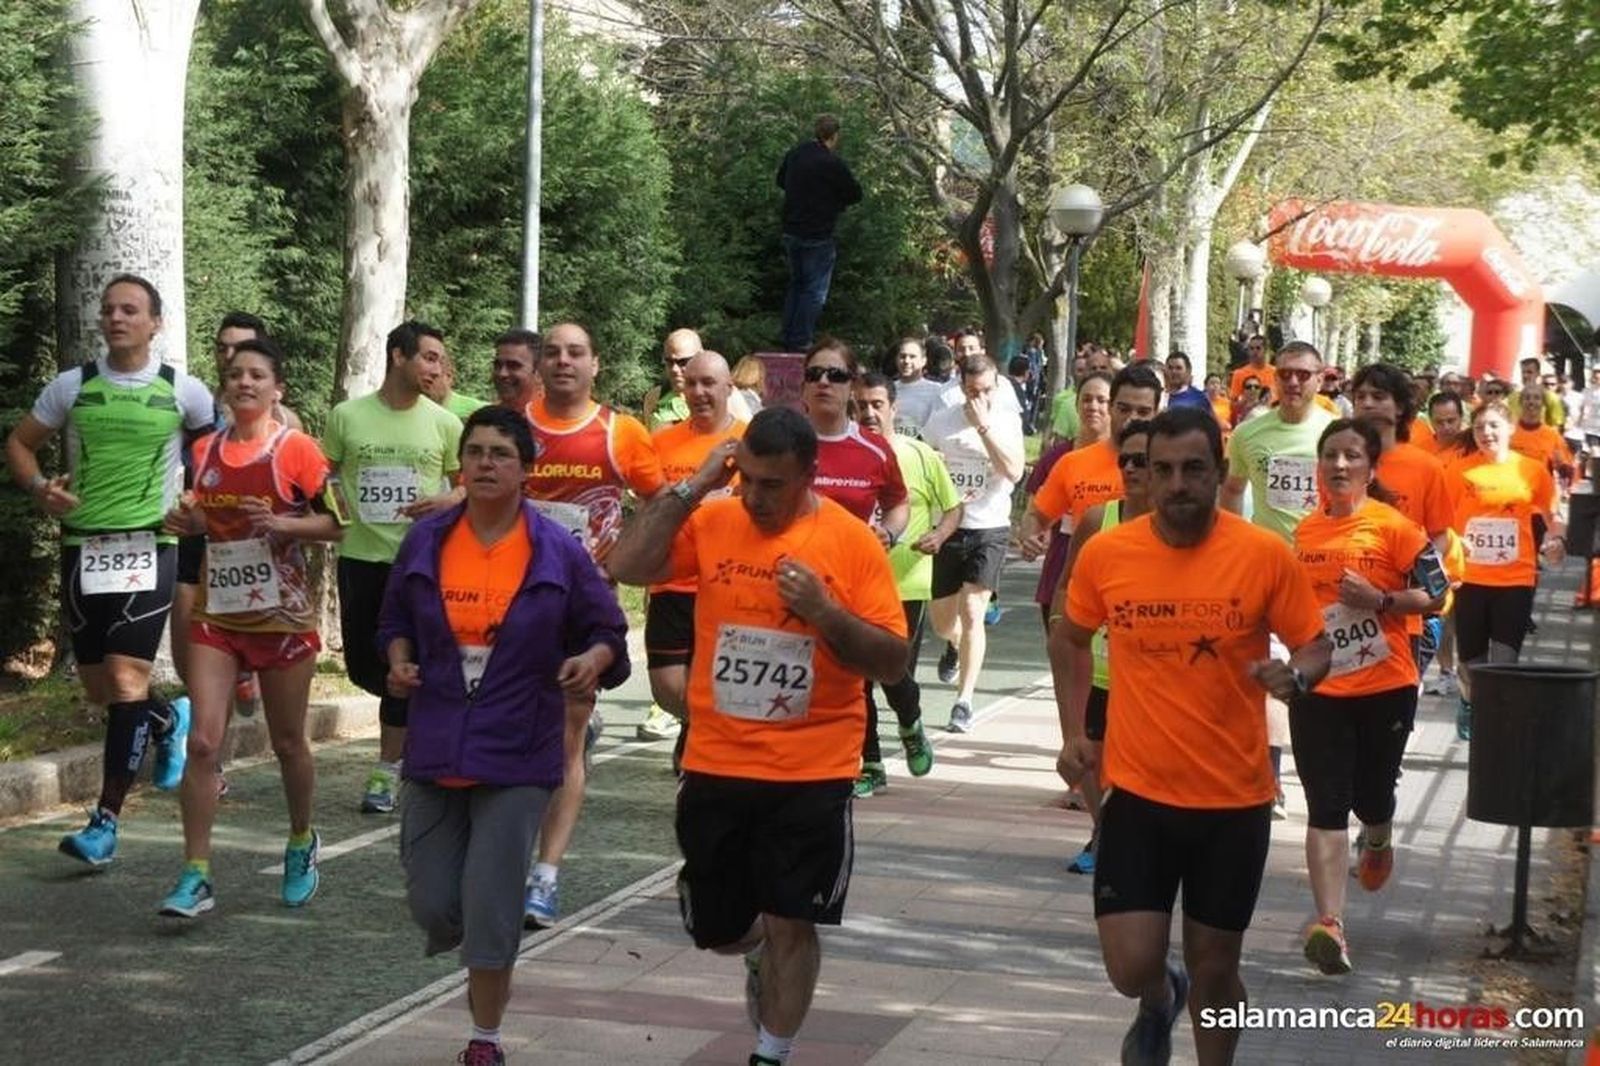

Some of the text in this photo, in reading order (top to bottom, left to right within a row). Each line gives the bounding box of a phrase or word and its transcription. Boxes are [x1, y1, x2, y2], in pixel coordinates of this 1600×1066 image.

[1269, 474, 1314, 492] 2611
[359, 486, 417, 503] 25915
[84, 551, 153, 573] 25823
[209, 562, 272, 589] 26089
[737, 563, 774, 581] RUN
[444, 589, 480, 604] RUN
[1136, 602, 1223, 618] RUN FOR
[715, 655, 808, 690] 25742
